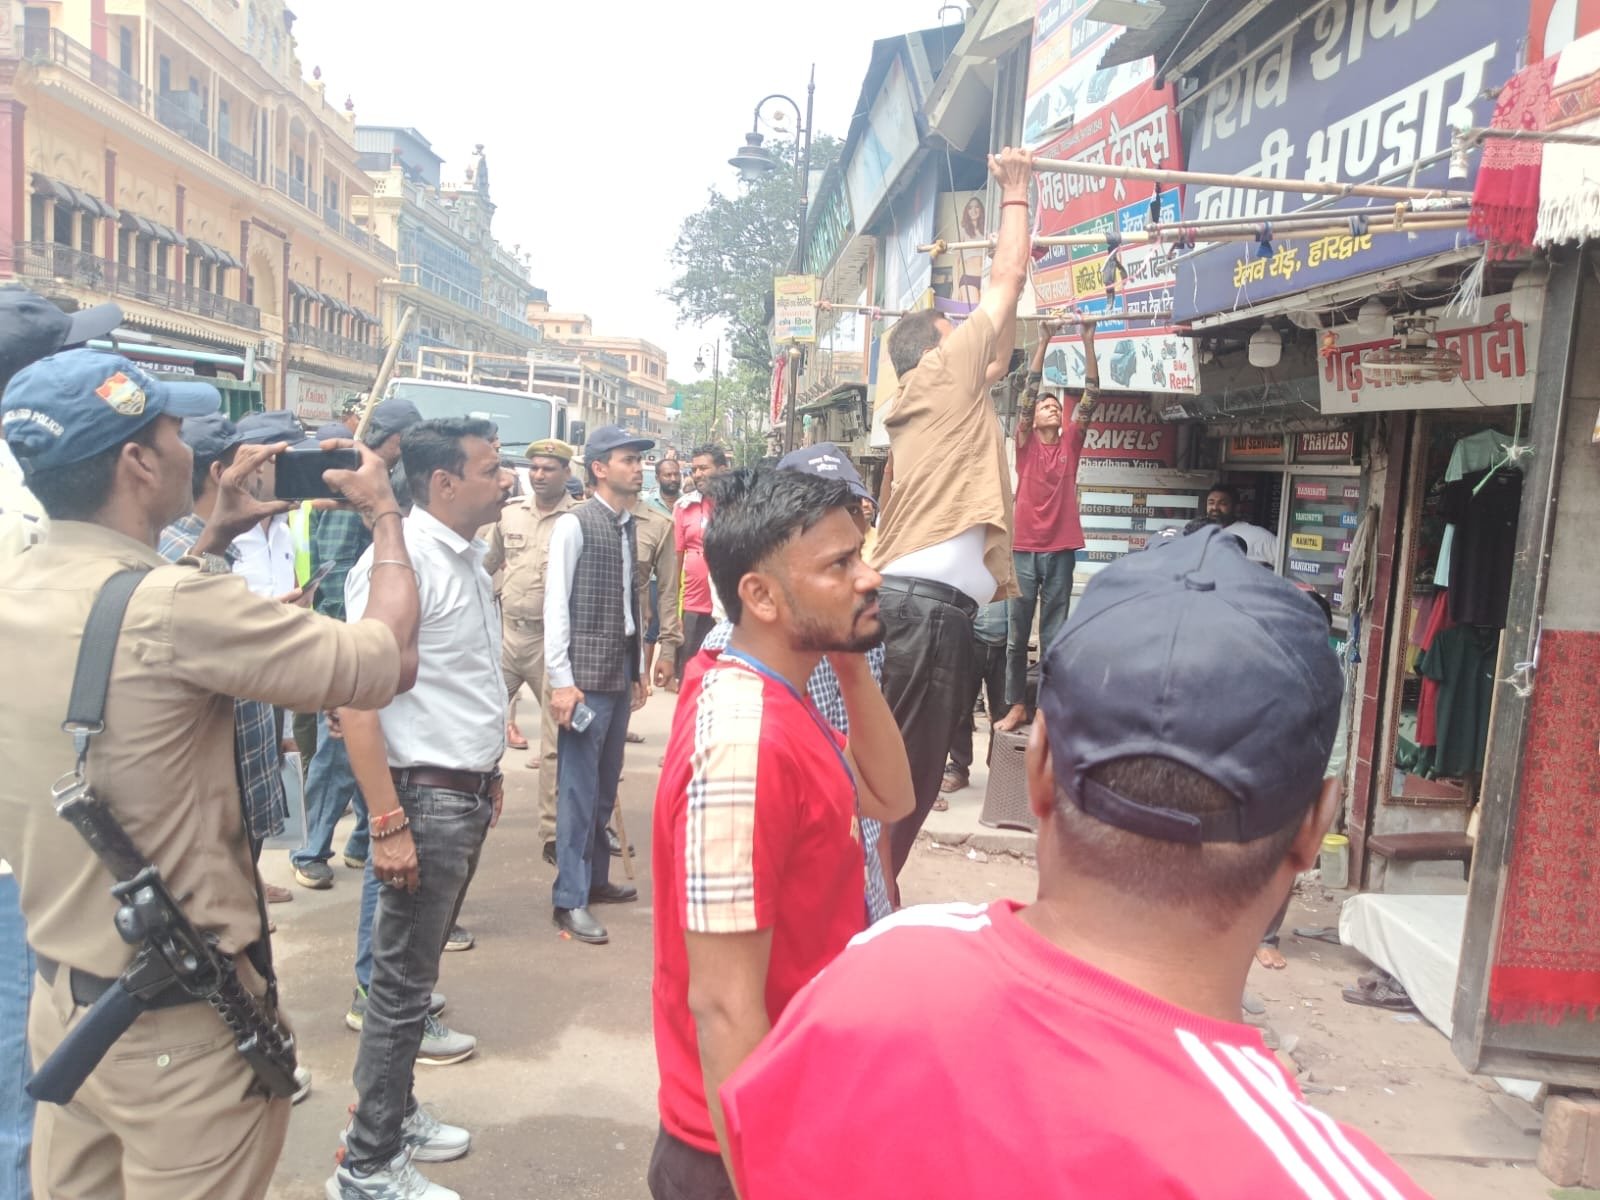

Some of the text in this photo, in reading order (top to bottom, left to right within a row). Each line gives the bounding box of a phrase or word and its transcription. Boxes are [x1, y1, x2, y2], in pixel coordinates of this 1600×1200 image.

[1233, 259, 1267, 288] रेलव
[1082, 428, 1163, 451] RAVELS
[1302, 431, 1350, 451] TRAVELS
